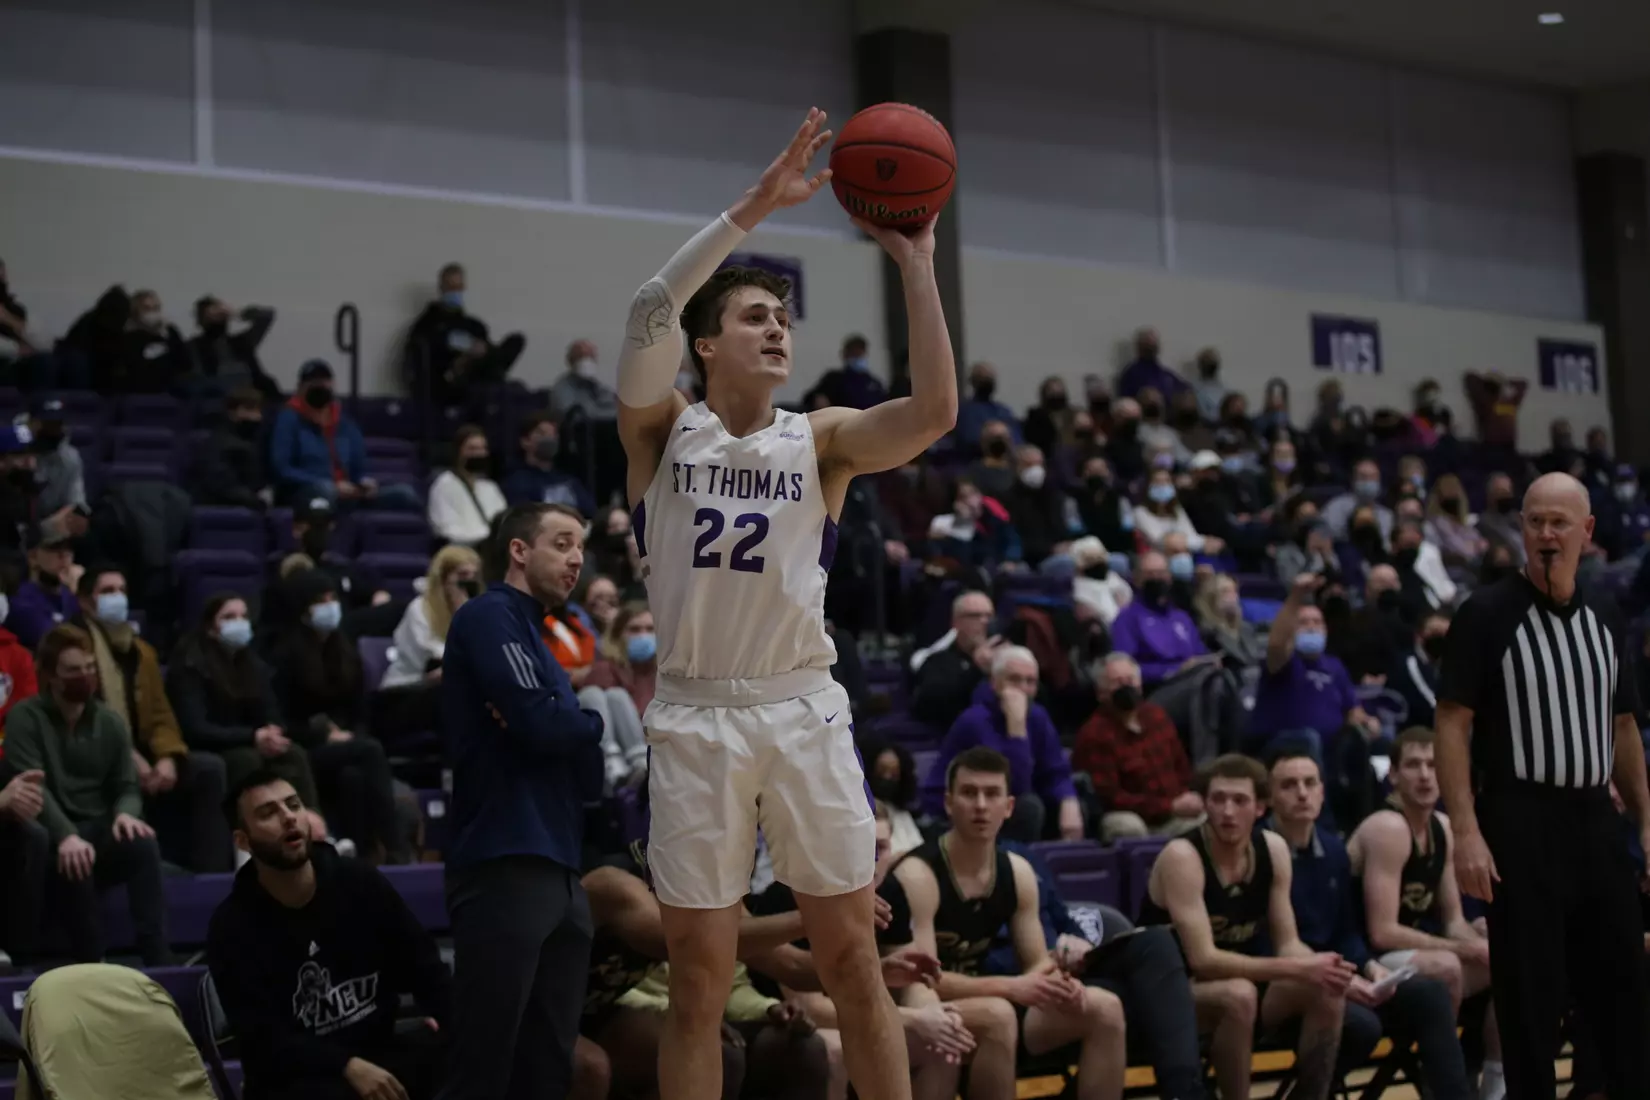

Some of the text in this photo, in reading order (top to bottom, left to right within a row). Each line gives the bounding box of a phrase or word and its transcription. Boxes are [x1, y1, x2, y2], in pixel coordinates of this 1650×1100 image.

[845, 190, 928, 220] Wilson
[672, 462, 803, 502] ST. THOMAS
[692, 507, 770, 573] 22
[314, 971, 379, 1028] NCU
